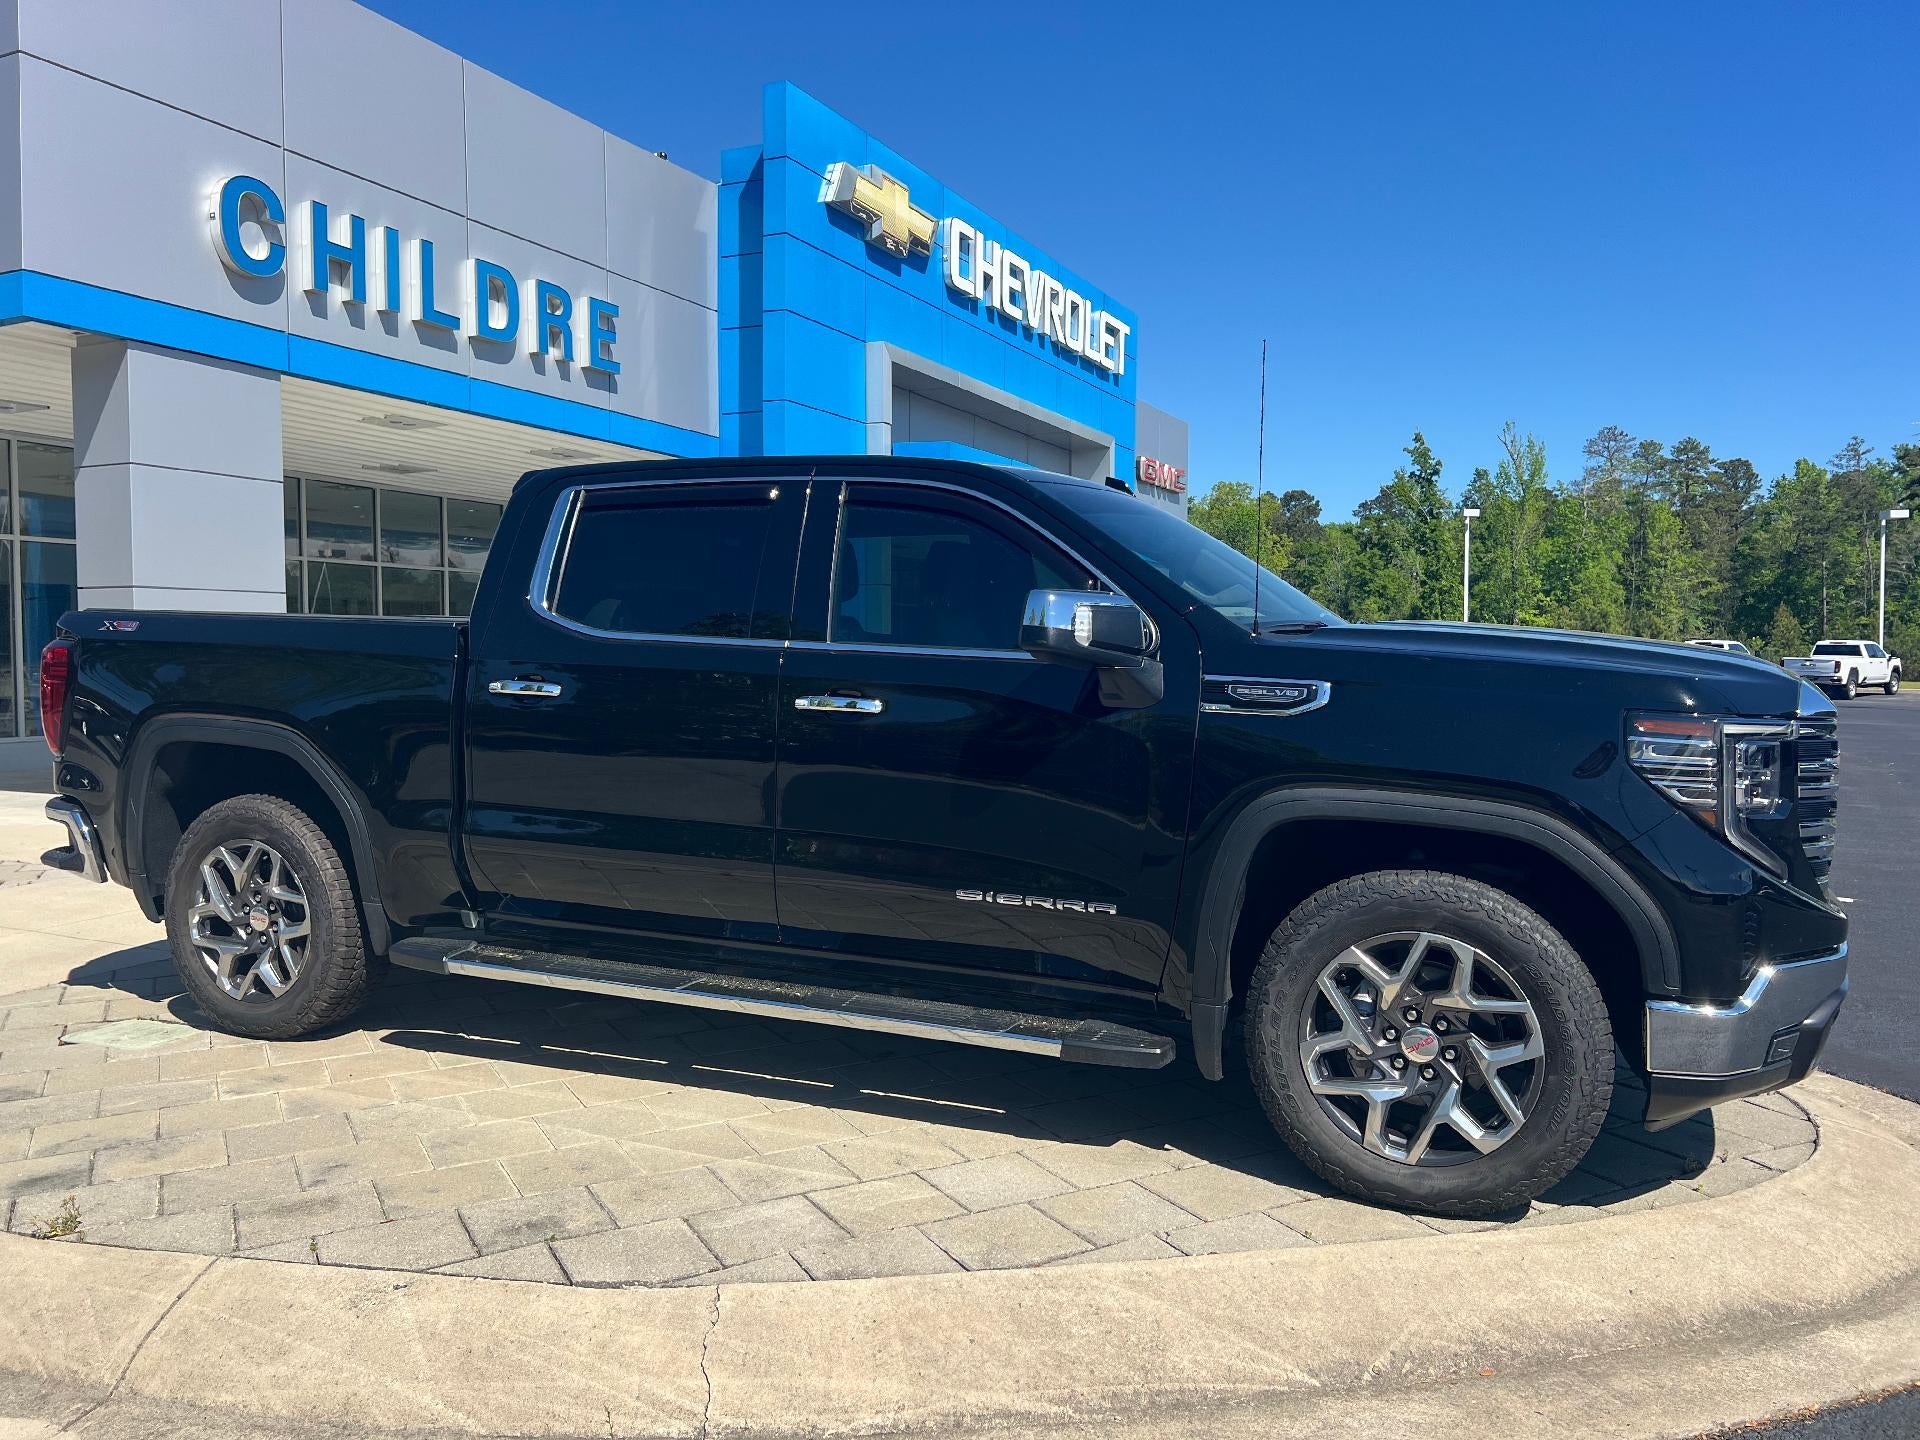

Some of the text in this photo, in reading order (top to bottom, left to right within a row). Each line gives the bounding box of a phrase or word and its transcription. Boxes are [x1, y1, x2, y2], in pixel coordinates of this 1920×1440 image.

[210, 175, 621, 375] CHILDRE
[942, 217, 1131, 376] CHEVROLET
[1137, 456, 1186, 492] GMC
[955, 889, 1117, 915] SIERRA
